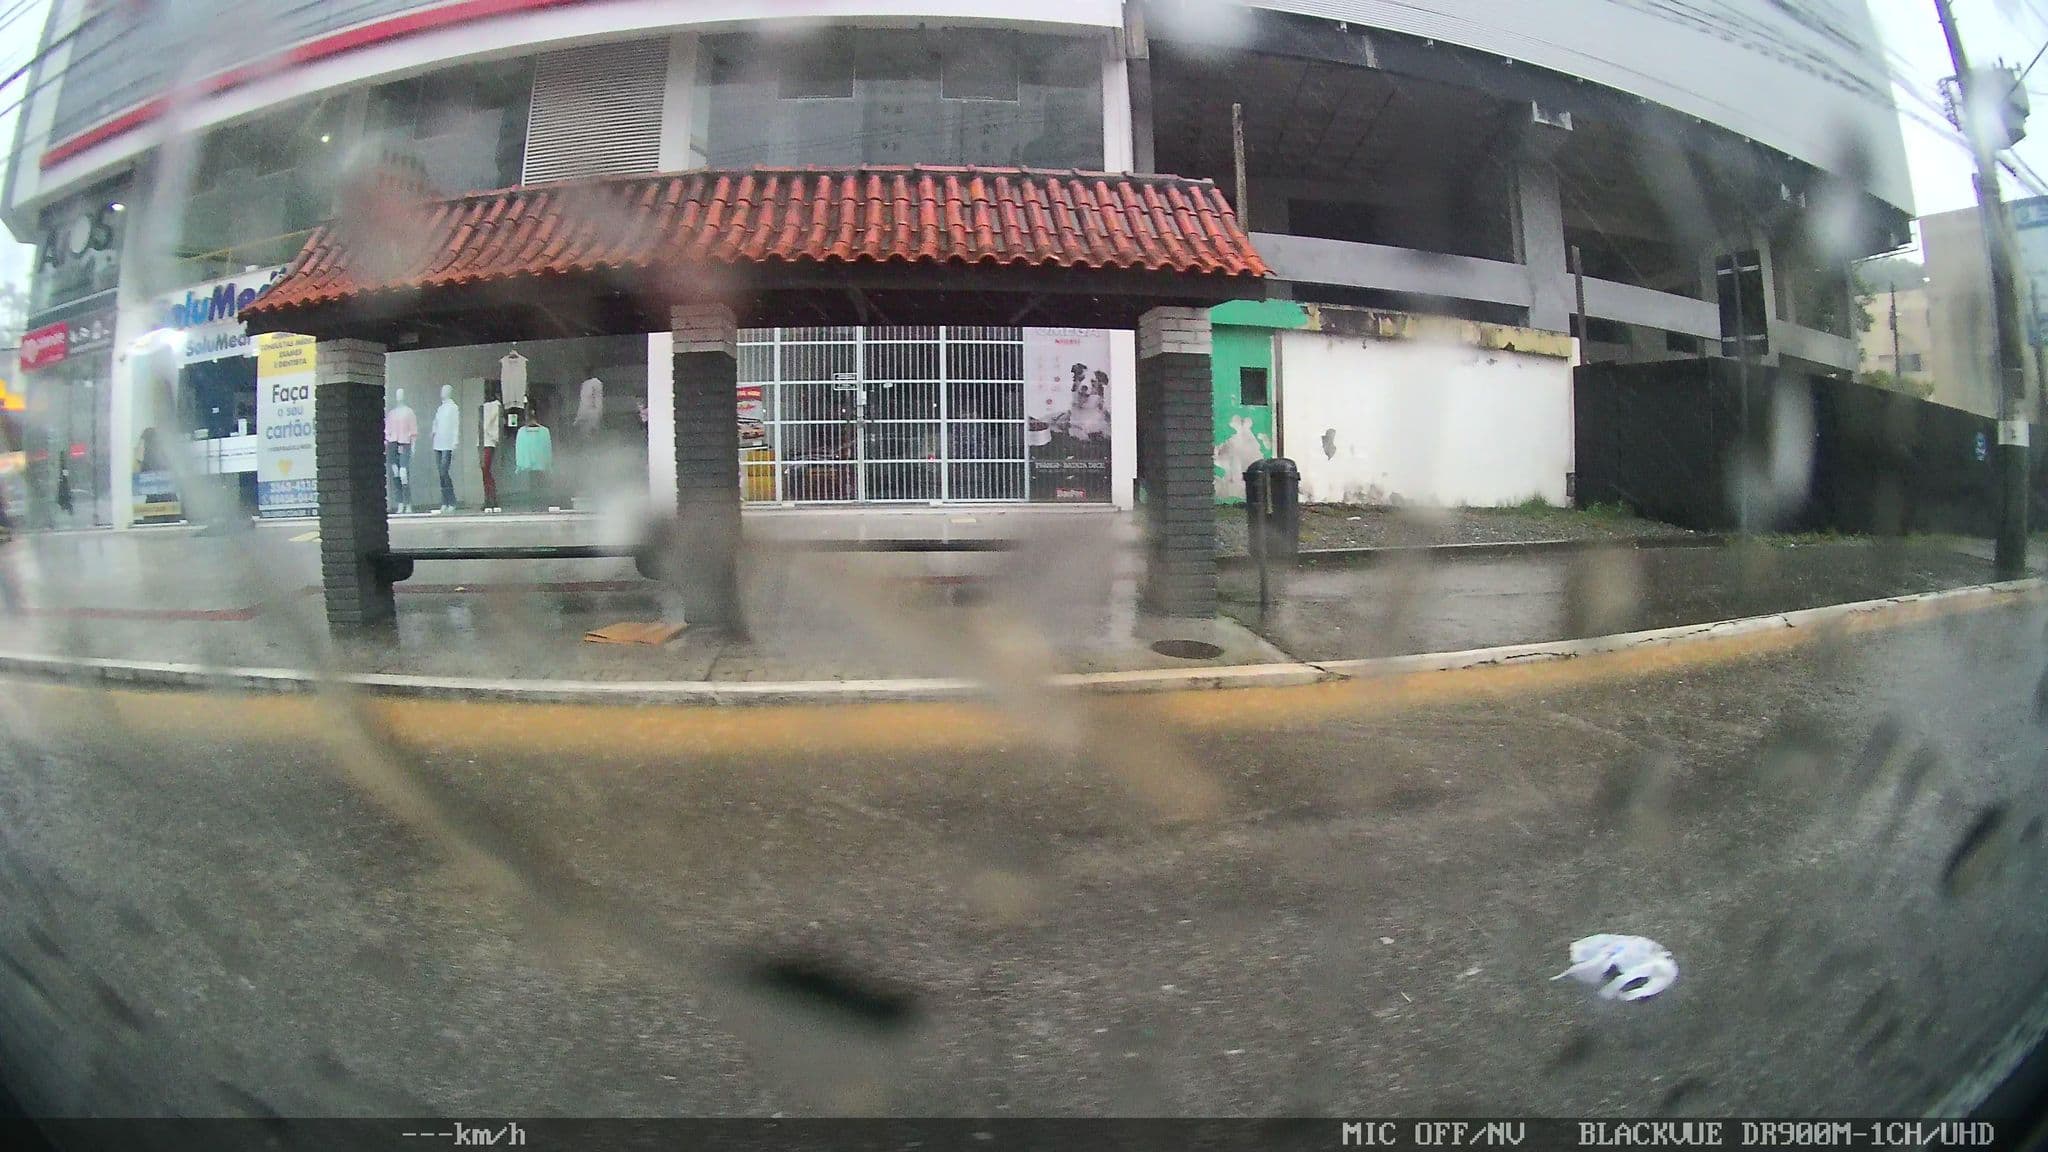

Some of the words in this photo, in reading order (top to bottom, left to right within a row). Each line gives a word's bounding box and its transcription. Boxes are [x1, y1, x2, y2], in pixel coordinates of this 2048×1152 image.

[272, 384, 309, 404] Faça
[277, 408, 284, 417] o
[286, 406, 304, 417] seu
[265, 419, 312, 440] cartão
